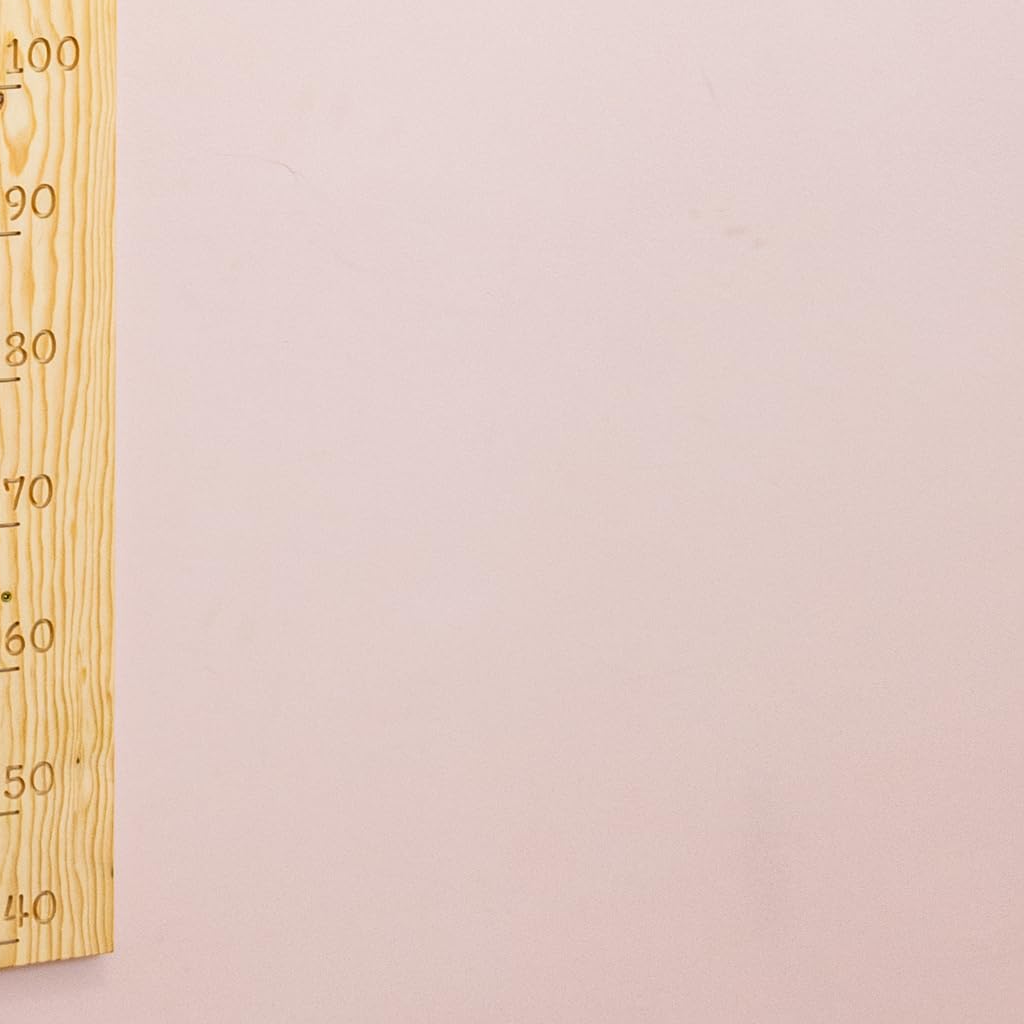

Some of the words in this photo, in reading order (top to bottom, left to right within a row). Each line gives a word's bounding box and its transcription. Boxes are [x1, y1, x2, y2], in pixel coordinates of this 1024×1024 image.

[6, 35, 80, 74] 100
[4, 183, 57, 221] 90
[4, 328, 57, 367] 80
[3, 473, 54, 511] 70
[4, 617, 55, 656] 60
[3, 761, 55, 800] 50
[3, 889, 57, 928] 40
